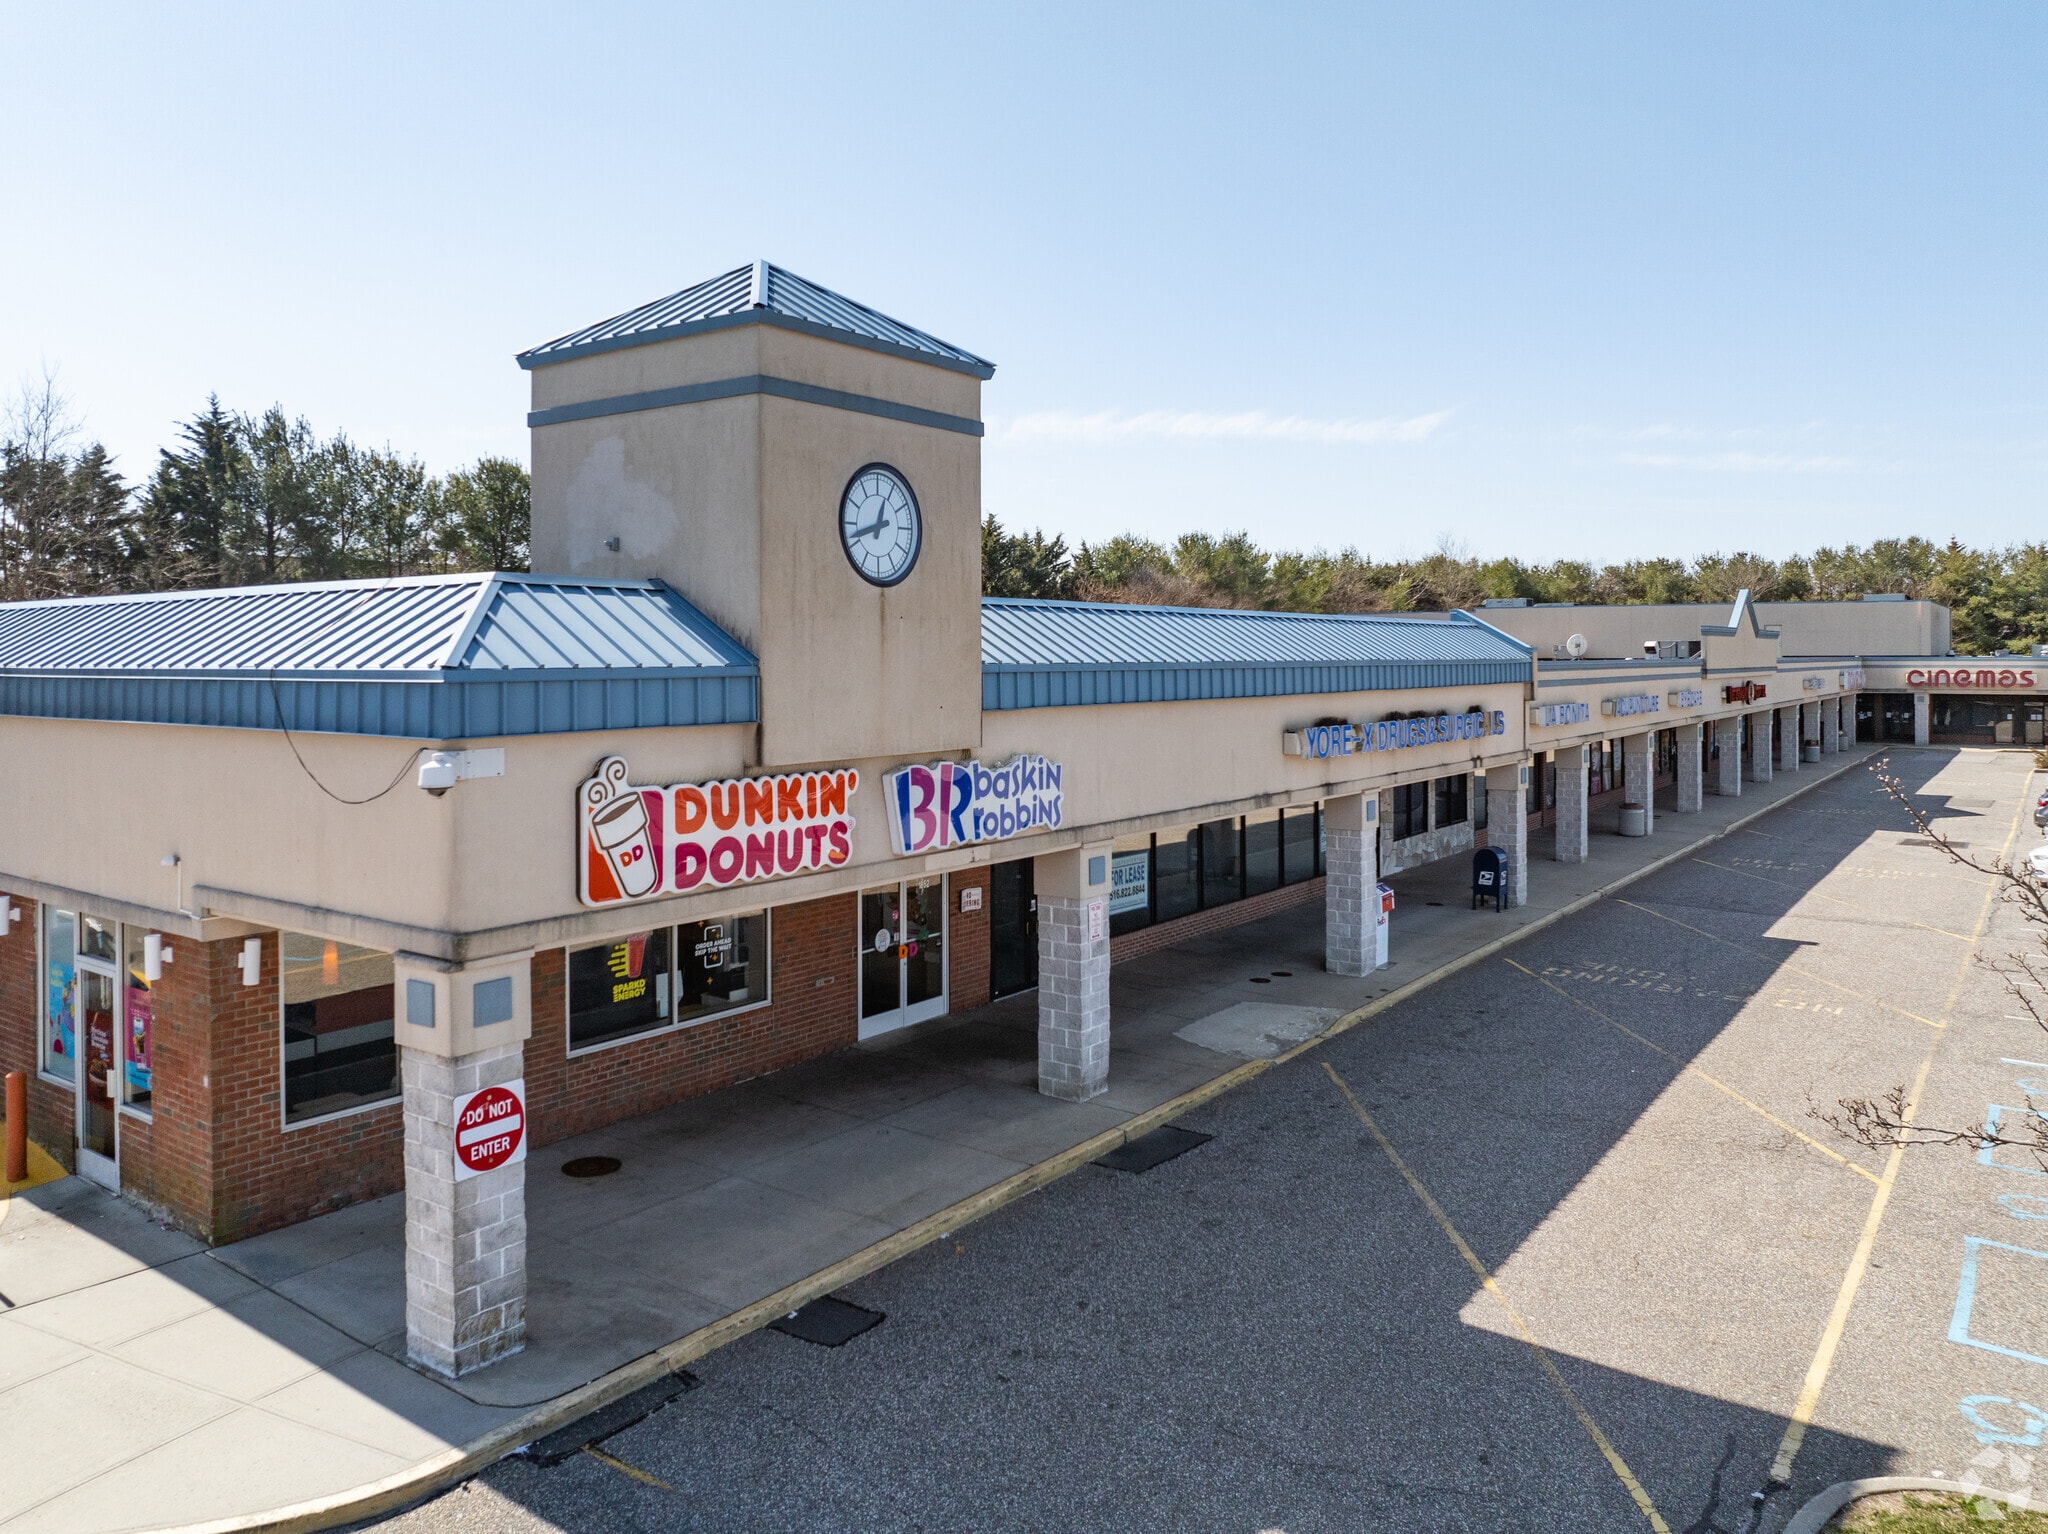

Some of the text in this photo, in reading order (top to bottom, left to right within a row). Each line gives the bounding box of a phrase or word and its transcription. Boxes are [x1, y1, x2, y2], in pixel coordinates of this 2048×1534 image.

[1559, 703, 1590, 725] BONITA
[674, 771, 857, 835] DUNKIN'
[619, 844, 644, 867] DD
[674, 820, 850, 890] DONUTS
[1125, 865, 1145, 884] LEASE
[695, 937, 732, 950] ORDER AHEAD
[719, 943, 732, 951] WAIT
[612, 987, 646, 1003] ENERGY
[466, 1098, 513, 1126] DO NOT
[471, 1136, 510, 1161] ENTER
